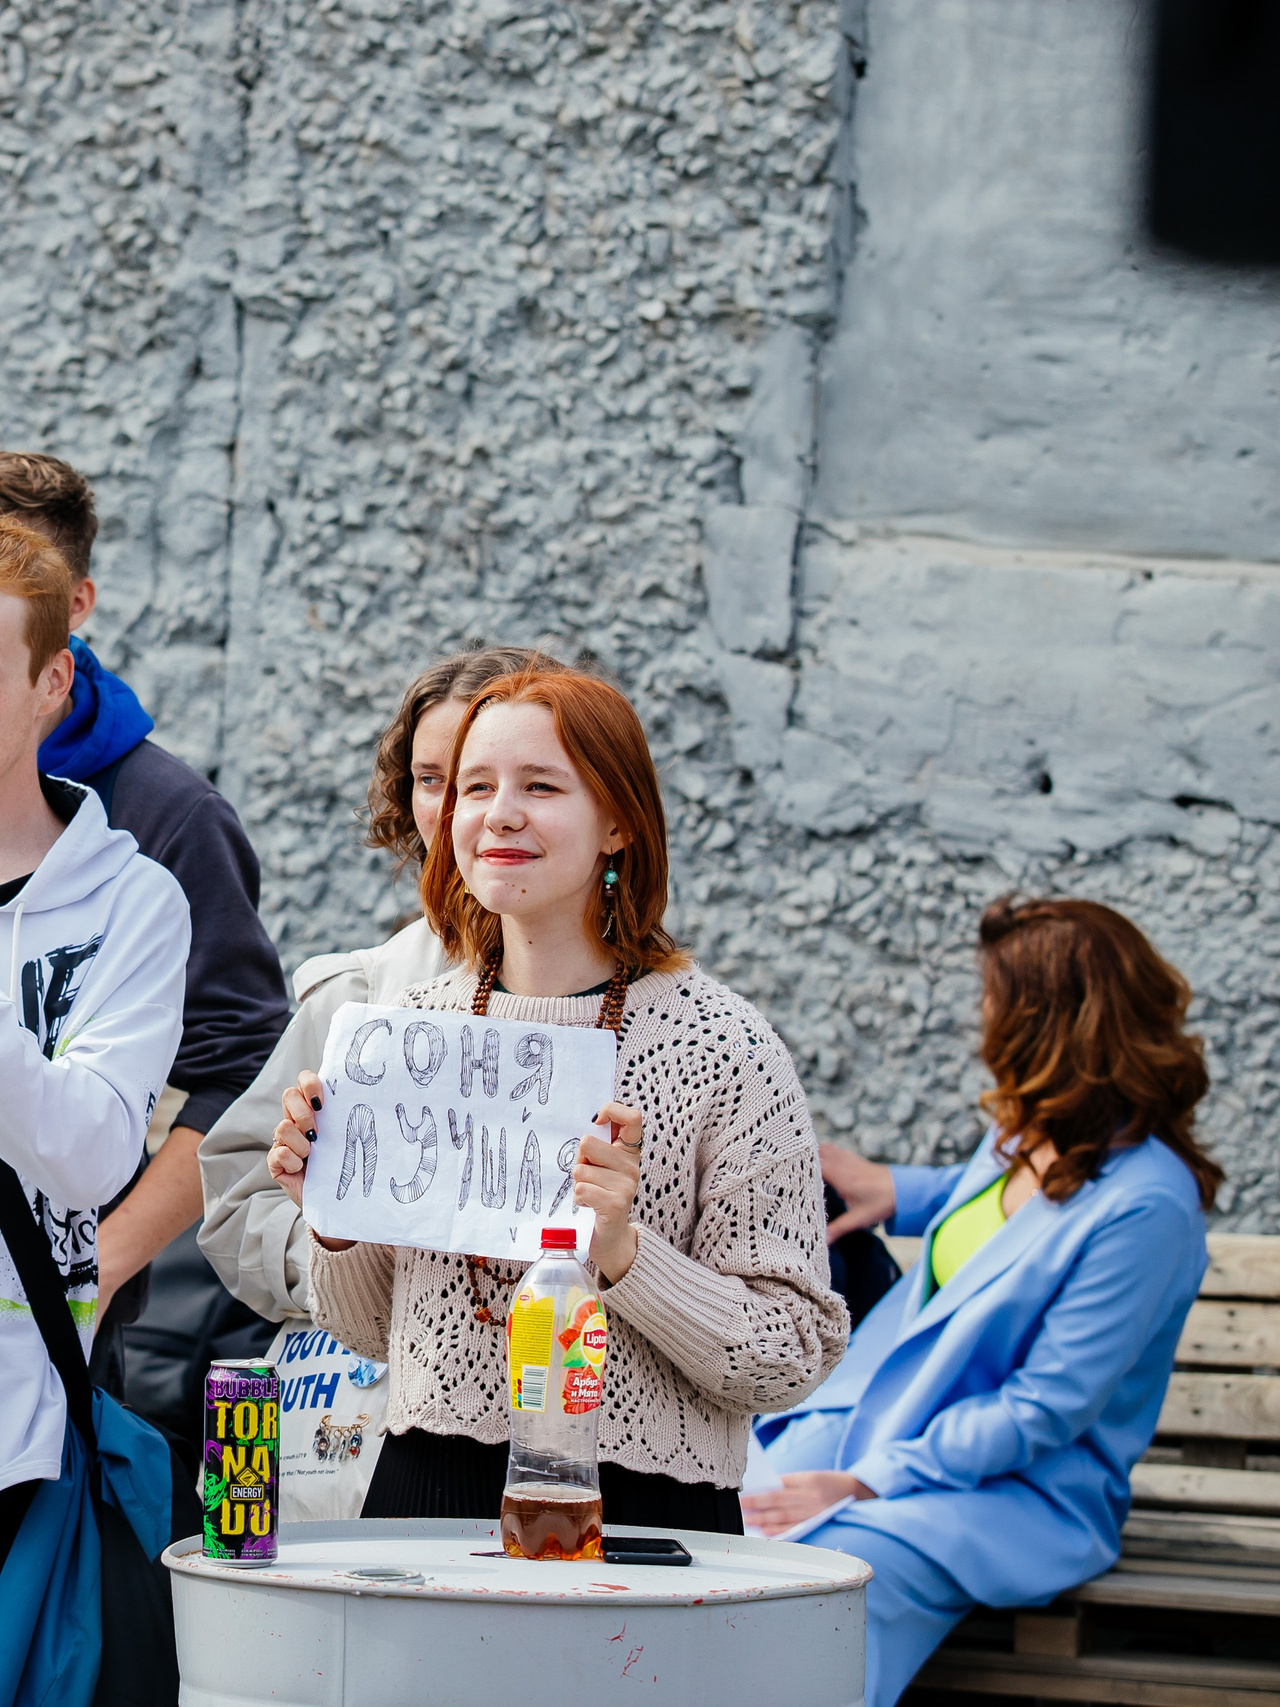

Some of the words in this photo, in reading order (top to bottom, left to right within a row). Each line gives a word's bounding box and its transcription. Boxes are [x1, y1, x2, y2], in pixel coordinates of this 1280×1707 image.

[344, 1017, 553, 1105] СОНЯ
[214, 1378, 278, 1399] BUBBLE
[571, 1390, 578, 1398] и
[578, 1388, 599, 1398] Мята
[572, 1376, 599, 1389] Арбуз
[214, 1401, 278, 1440] TOR
[221, 1445, 271, 1484] NA
[232, 1486, 263, 1498] ENERGY
